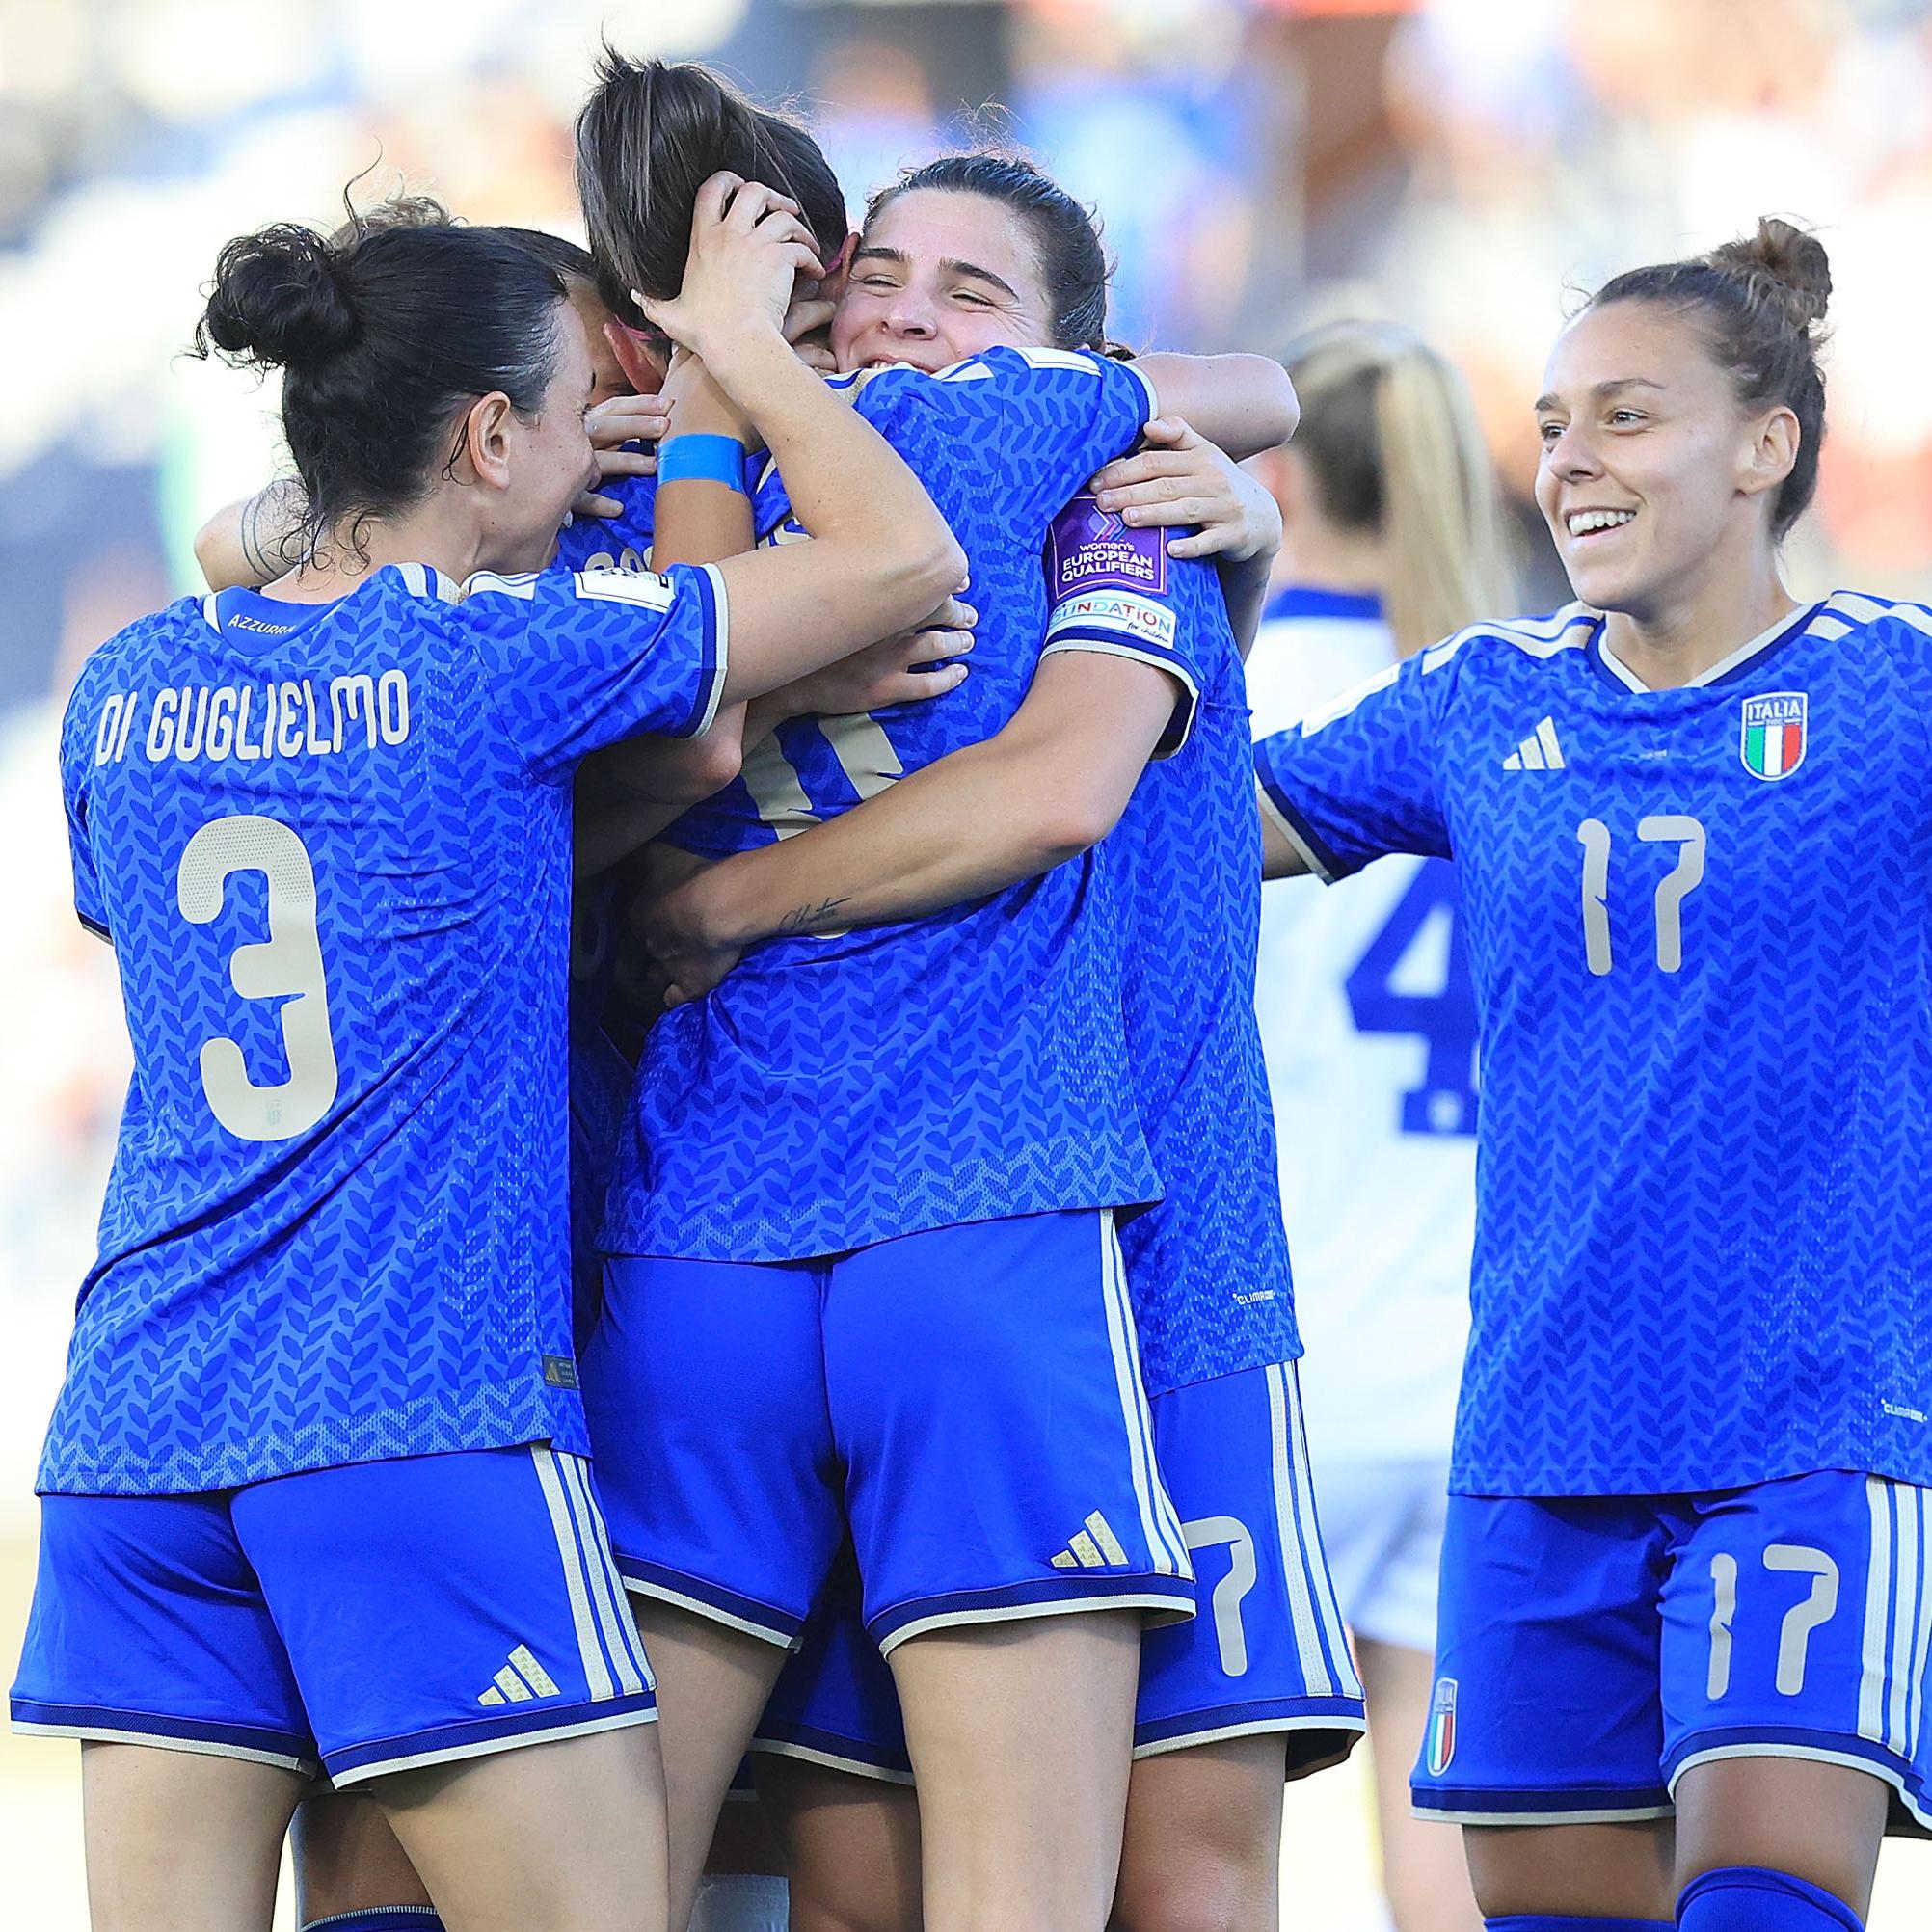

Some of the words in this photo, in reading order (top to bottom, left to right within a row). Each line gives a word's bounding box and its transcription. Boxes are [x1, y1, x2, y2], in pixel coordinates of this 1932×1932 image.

[1061, 562, 1155, 582] QUALIFIERS
[1062, 550, 1153, 572] EUROPEAN
[95, 691, 138, 766] DI
[146, 669, 410, 762] GUGLIELMO
[1748, 699, 1802, 721] ITALIA
[1577, 816, 1705, 976] 17
[178, 815, 337, 1140] 3
[1346, 857, 1479, 1134] 4
[1706, 1543, 1839, 1700] 17
